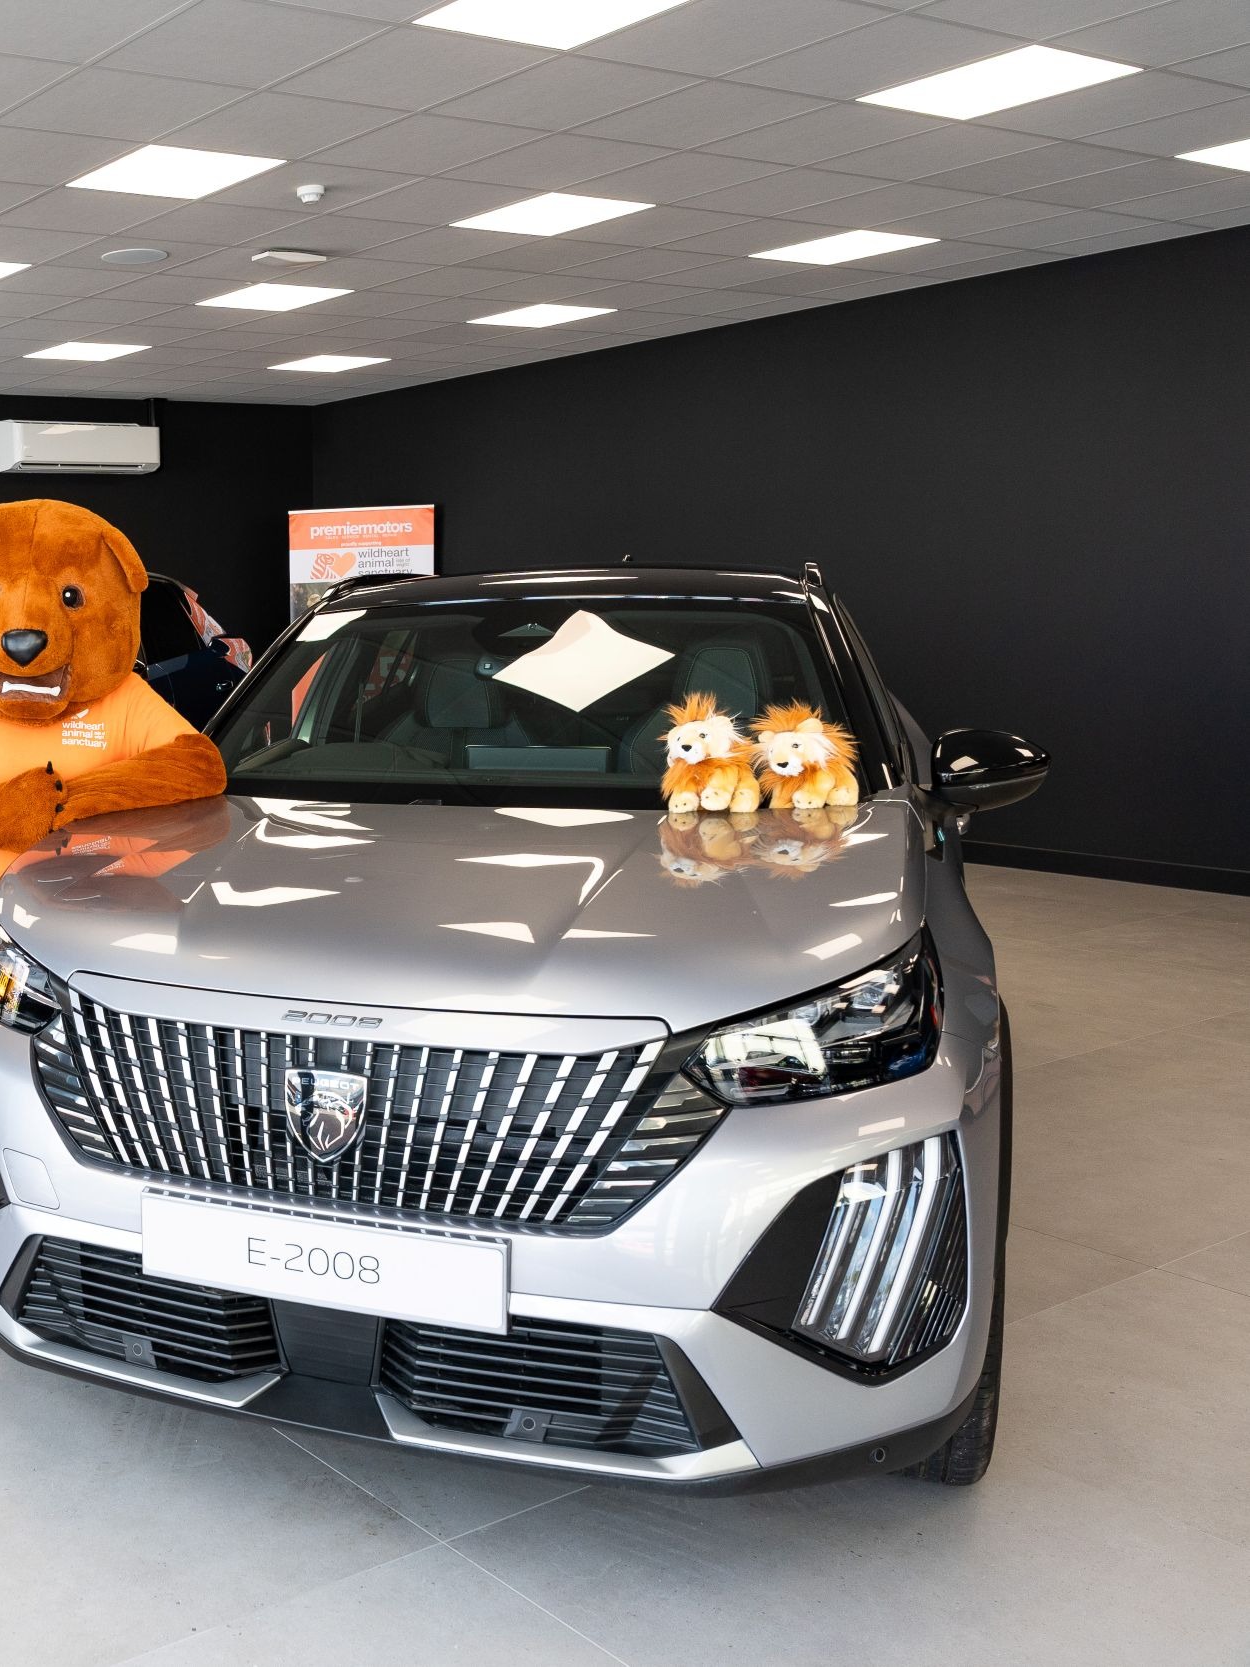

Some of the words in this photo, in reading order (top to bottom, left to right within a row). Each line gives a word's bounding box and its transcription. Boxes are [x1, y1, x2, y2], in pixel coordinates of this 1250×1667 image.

[310, 521, 413, 539] premiermotors
[358, 548, 410, 558] wildheart
[358, 558, 395, 569] animal
[62, 721, 104, 730] wildheart
[62, 730, 93, 738] animal
[62, 738, 107, 750] sanctuary
[281, 1009, 383, 1029] 2008
[248, 1237, 380, 1284] E-2008
